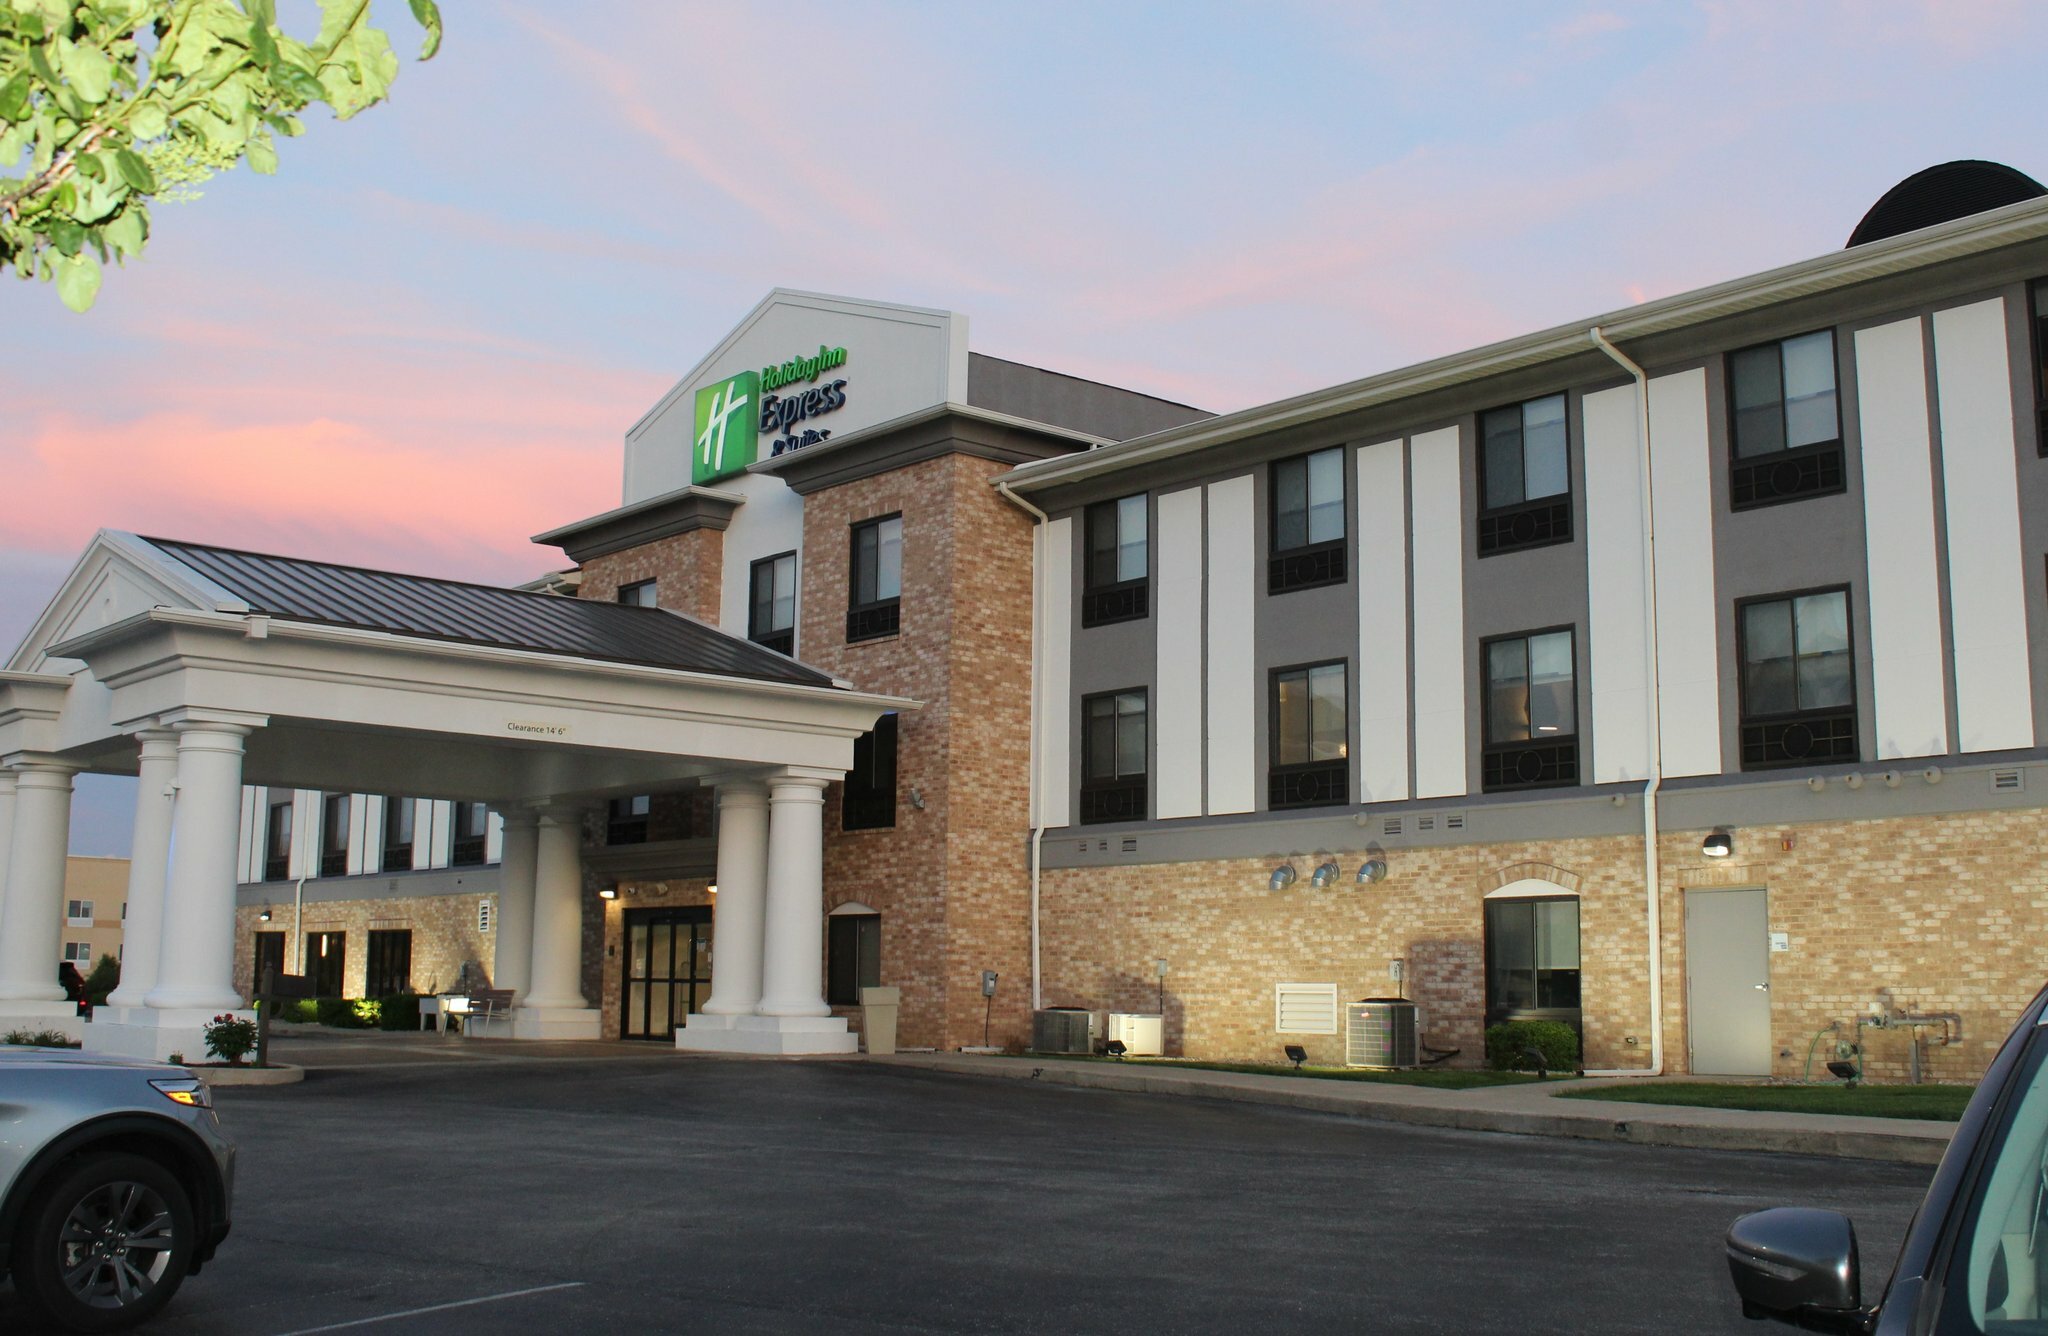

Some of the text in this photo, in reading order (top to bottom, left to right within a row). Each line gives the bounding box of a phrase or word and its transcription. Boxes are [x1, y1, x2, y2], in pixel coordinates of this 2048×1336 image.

[817, 345, 847, 371] Inn
[759, 379, 847, 435] Express
[507, 722, 545, 734] Clearance
